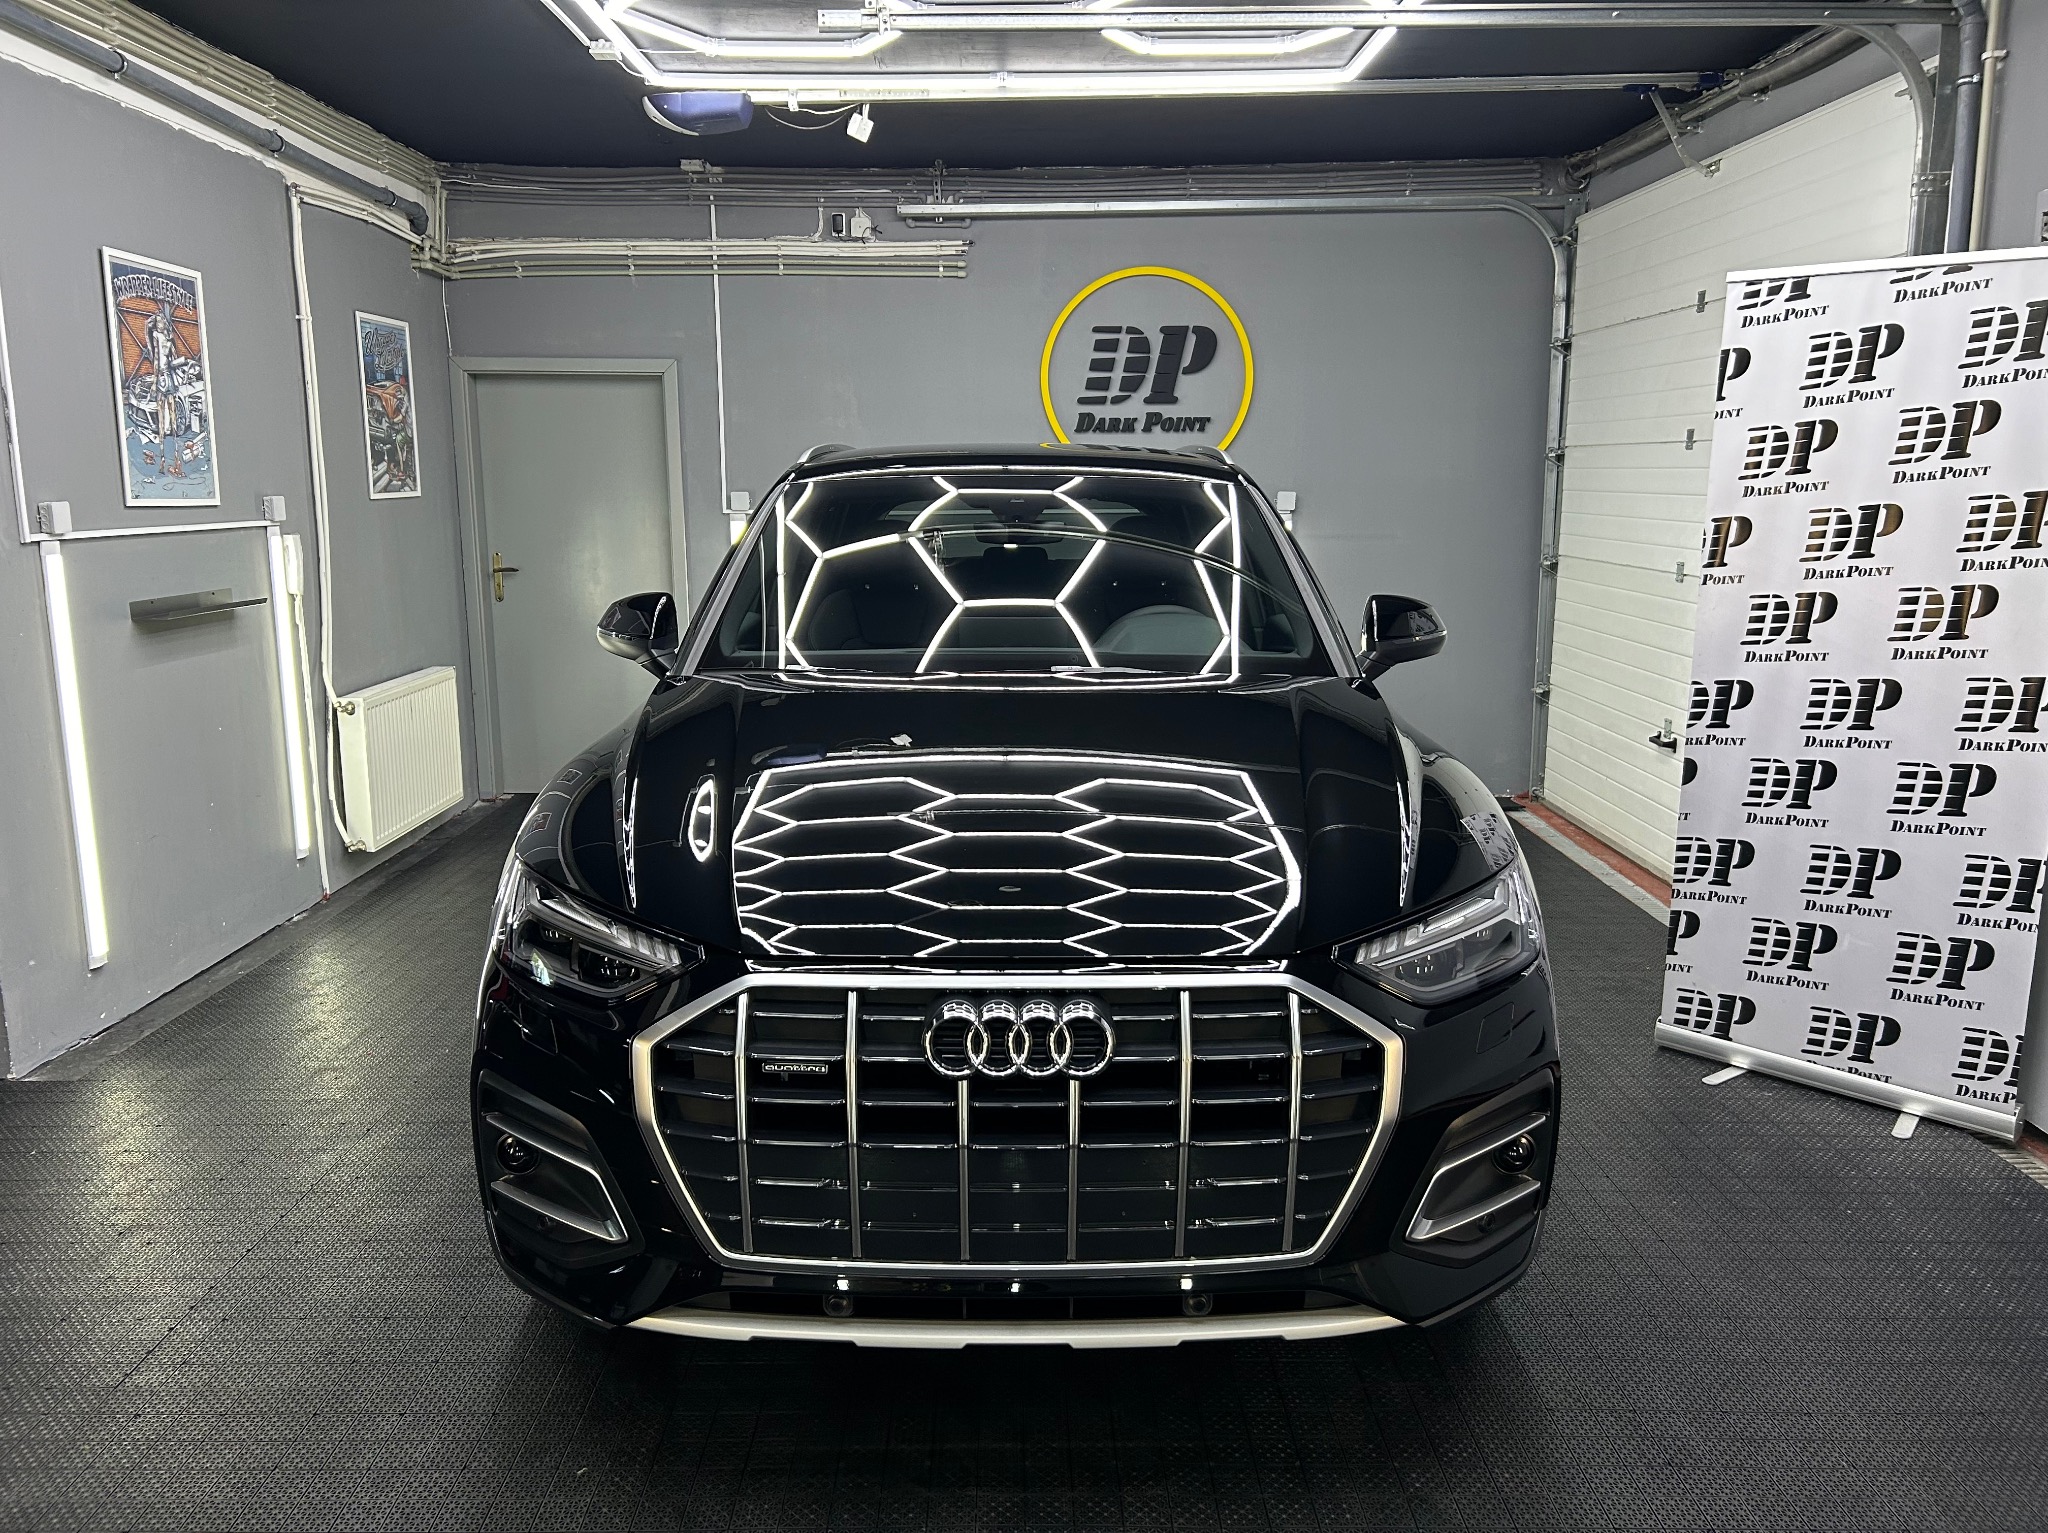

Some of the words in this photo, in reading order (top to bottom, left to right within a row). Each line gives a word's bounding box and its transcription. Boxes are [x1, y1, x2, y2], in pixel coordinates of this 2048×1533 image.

[1893, 277, 1994, 304] DARKPOINT
[1740, 305, 1830, 329] DARKPOINT
[1077, 325, 1218, 405] DP
[1799, 323, 1905, 391] DP
[1715, 347, 1752, 402] P
[1961, 368, 2048, 389] DARKPOI
[1802, 387, 1895, 409] DARKPOINT
[1074, 412, 1138, 433] DARK
[1141, 411, 1211, 433] POINT
[1888, 399, 2002, 466] DP
[1738, 418, 1839, 480] DP
[1892, 465, 1991, 484] DARKPOINT
[1742, 480, 1830, 498] DARKPOINT
[1702, 516, 1753, 569] P
[1799, 503, 1904, 562] DP
[1701, 573, 1745, 586] POINT
[1803, 565, 1894, 581] DARKPOINT
[1740, 591, 1839, 645] DP
[1887, 584, 2000, 643] DP
[1744, 650, 1830, 663] DARKPOINT
[1891, 646, 1989, 661] DARKPOINT
[1800, 678, 1903, 731] DP
[1685, 734, 1746, 747] RKPOINT
[1803, 735, 1893, 750] DARKPOINT
[1957, 738, 2048, 753] DARKPOIN
[1742, 758, 1838, 810] DP
[1886, 761, 1998, 818] DP
[1745, 812, 1829, 828] DARKPOINT
[1889, 820, 1987, 837] DARKPOINT
[1672, 837, 1756, 887] DP
[1800, 844, 1902, 899] DP
[1671, 888, 1748, 905] DARKPOINT
[1803, 899, 1893, 919] DARKPOINT
[1666, 910, 1701, 955] P
[1957, 913, 2039, 934] DARKPOI
[1742, 917, 1838, 972] DP
[1885, 931, 1995, 990] DP
[1746, 970, 1830, 991] DARKPOINT
[1890, 988, 1985, 1011] DARKPOINT
[1673, 987, 1756, 1041] DP
[1800, 1006, 1902, 1064] DP
[765, 1064, 826, 1073] quattro
[1955, 1084, 2018, 1104] DARKP
